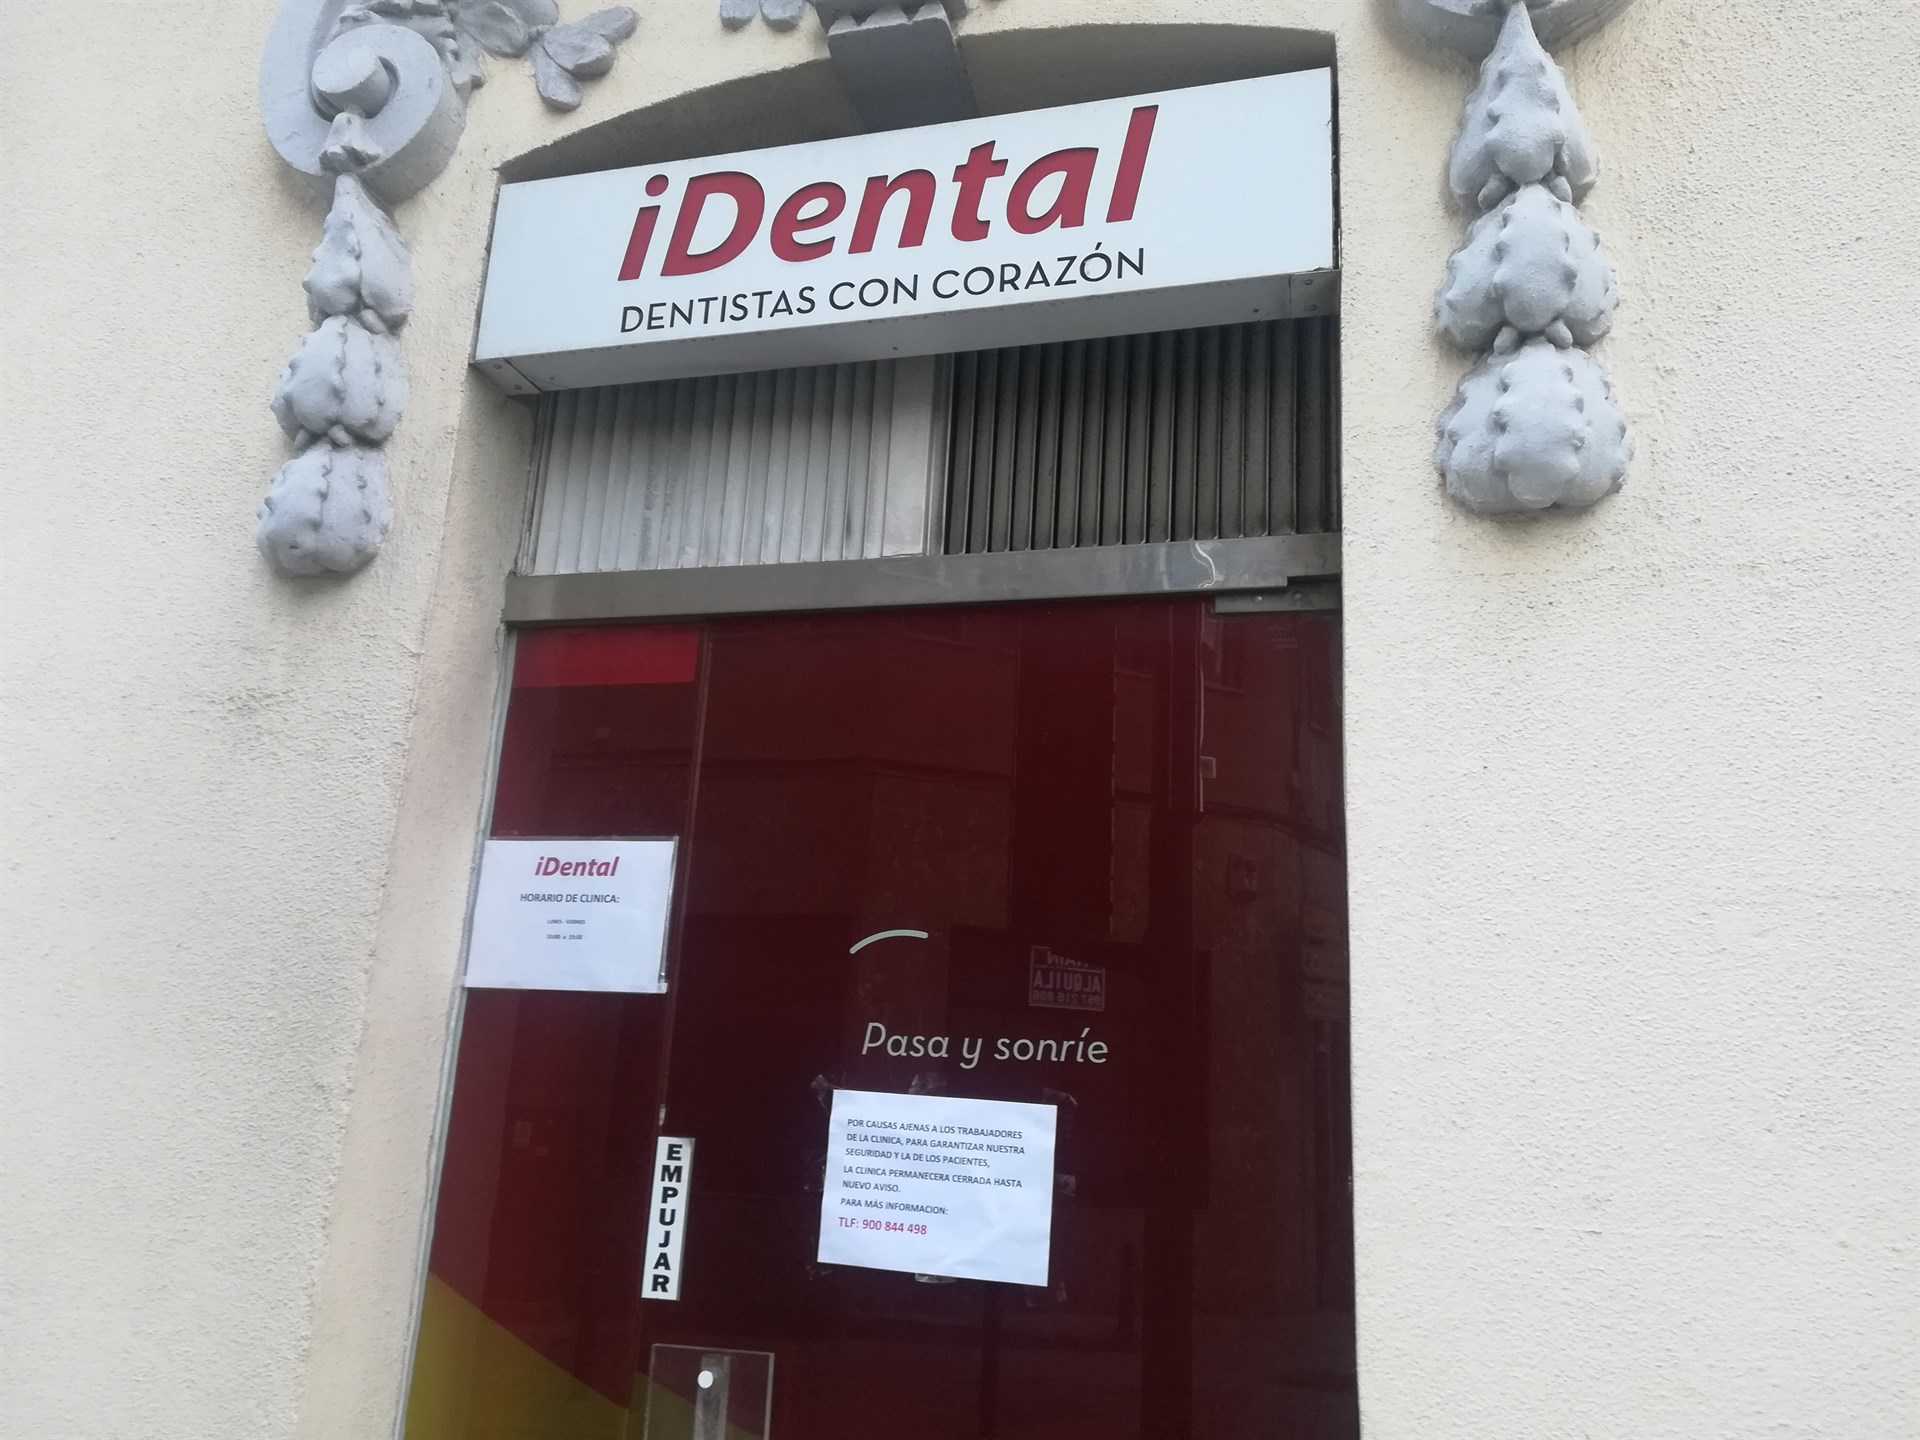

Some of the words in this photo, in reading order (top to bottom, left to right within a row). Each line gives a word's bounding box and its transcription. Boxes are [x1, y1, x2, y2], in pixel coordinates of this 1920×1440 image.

[617, 105, 1159, 281] iDental
[620, 285, 816, 334] DENTISTAS
[828, 274, 919, 311] CON
[932, 242, 1145, 299] CORAZÓN
[535, 856, 620, 877] iDental
[520, 893, 563, 903] HORARIO
[565, 893, 578, 903] DE
[862, 1022, 949, 1058] Pasa
[960, 1036, 983, 1069] y
[994, 1027, 1109, 1063] sonríe
[847, 1118, 865, 1128] POR
[866, 1120, 898, 1130] CAUSAS
[900, 1122, 930, 1133] AJENAS
[931, 1125, 938, 1133] A
[940, 1125, 955, 1134] LOS
[957, 1126, 1023, 1139] TRABAJADORES
[847, 1133, 858, 1142] DE
[859, 1134, 870, 1143] LA
[871, 1134, 904, 1146] CLINICA,
[906, 1137, 928, 1148] PARA
[930, 1139, 984, 1152] GARANTIZAR
[986, 1143, 1025, 1154] NUESTRA
[845, 1147, 892, 1159] SEGURIDAD
[893, 1151, 900, 1159] Y
[901, 1152, 911, 1160] LA
[912, 1153, 924, 1162] DE
[926, 1153, 941, 1163] LOS
[942, 1155, 990, 1168] PACIENTES,
[842, 1180, 872, 1191] NUEVO
[873, 1182, 901, 1193] AVISO.
[843, 1165, 853, 1174] LA
[855, 1166, 887, 1177] CLINICA
[888, 1168, 950, 1182] PERMANECERA
[952, 1174, 991, 1186] CERRADA
[993, 1177, 1023, 1188] HASTA
[840, 1197, 862, 1208] PARA
[864, 1198, 884, 1209] MÁS
[885, 1201, 949, 1215] INFORMACION:
[651, 1143, 683, 1293] EMPUJAR
[838, 1216, 860, 1229] TLF:
[862, 1219, 882, 1231] 900
[884, 1221, 904, 1233] 844
[907, 1223, 928, 1235] 498
